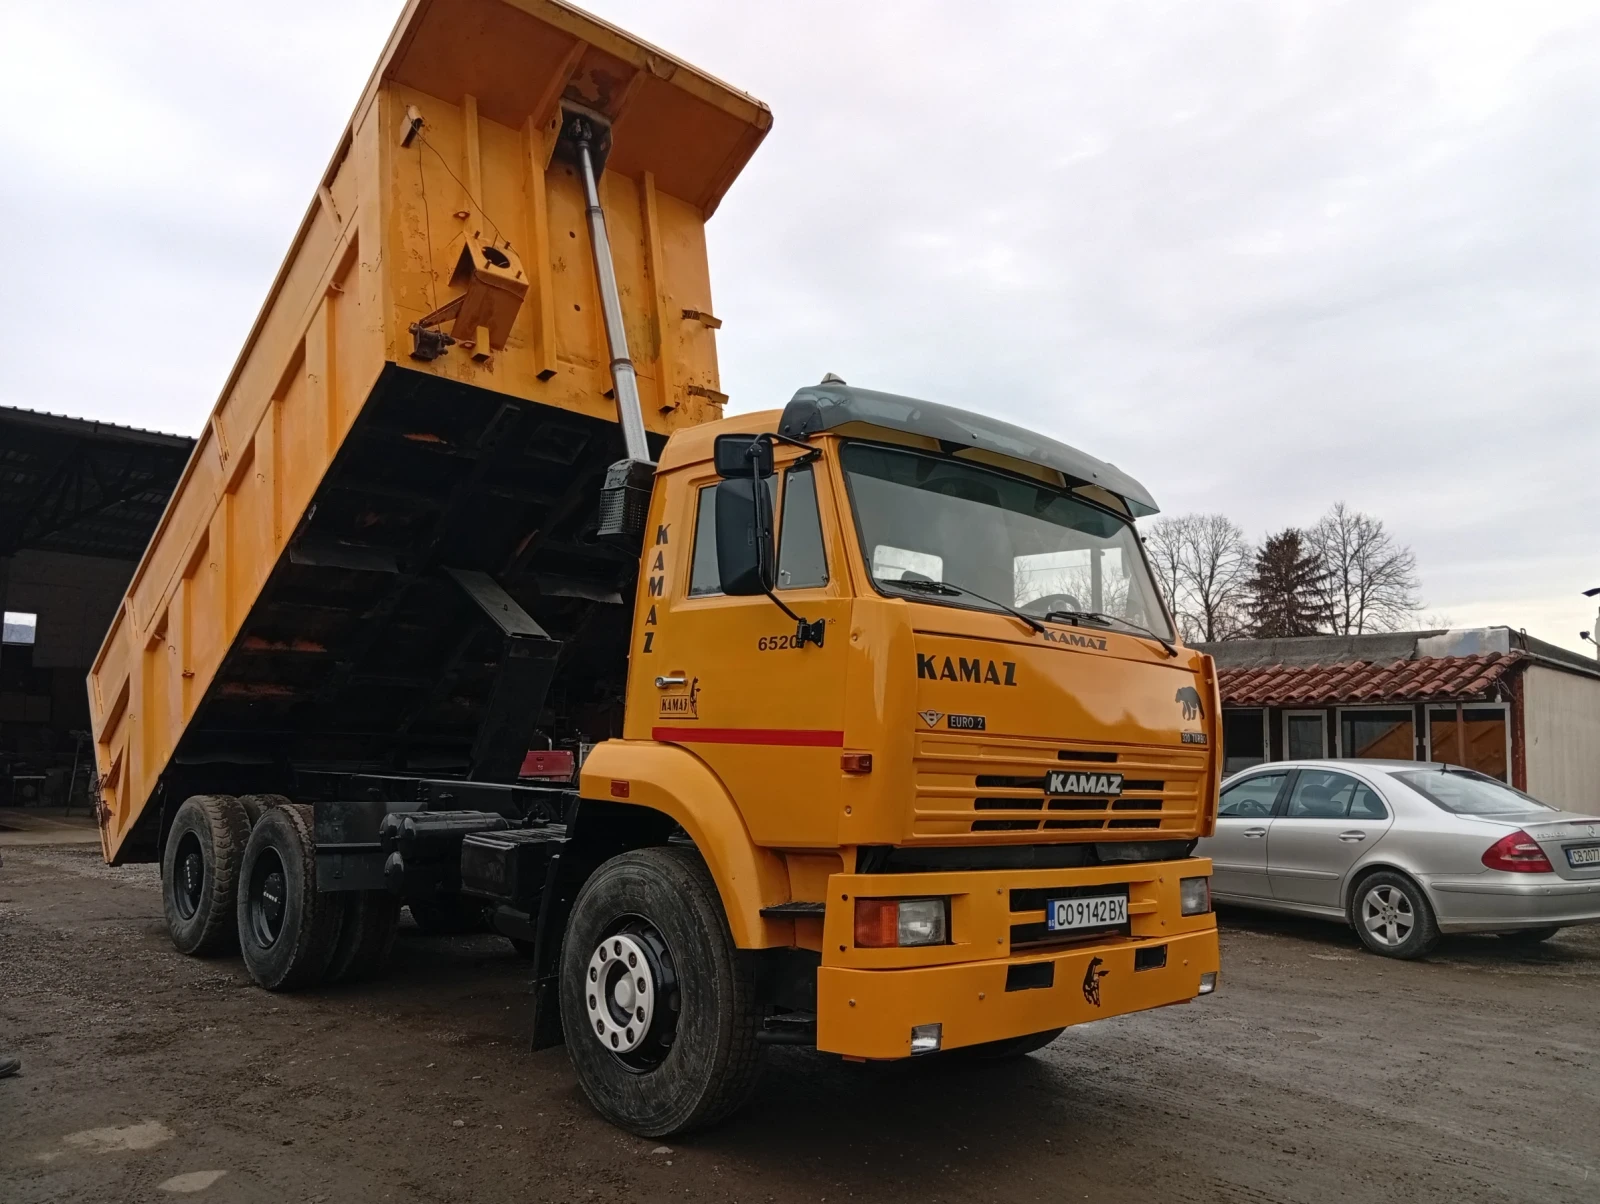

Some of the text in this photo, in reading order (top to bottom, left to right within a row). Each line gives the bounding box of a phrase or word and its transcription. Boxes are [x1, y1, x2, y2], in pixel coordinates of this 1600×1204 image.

[643, 523, 671, 653] KAMAZ
[758, 634, 798, 651] 6520
[1043, 630, 1108, 651] KAMAZ
[917, 653, 1017, 686] KAMAZ
[950, 716, 983, 729] EURO 2
[1050, 773, 1123, 794] KAMAZ
